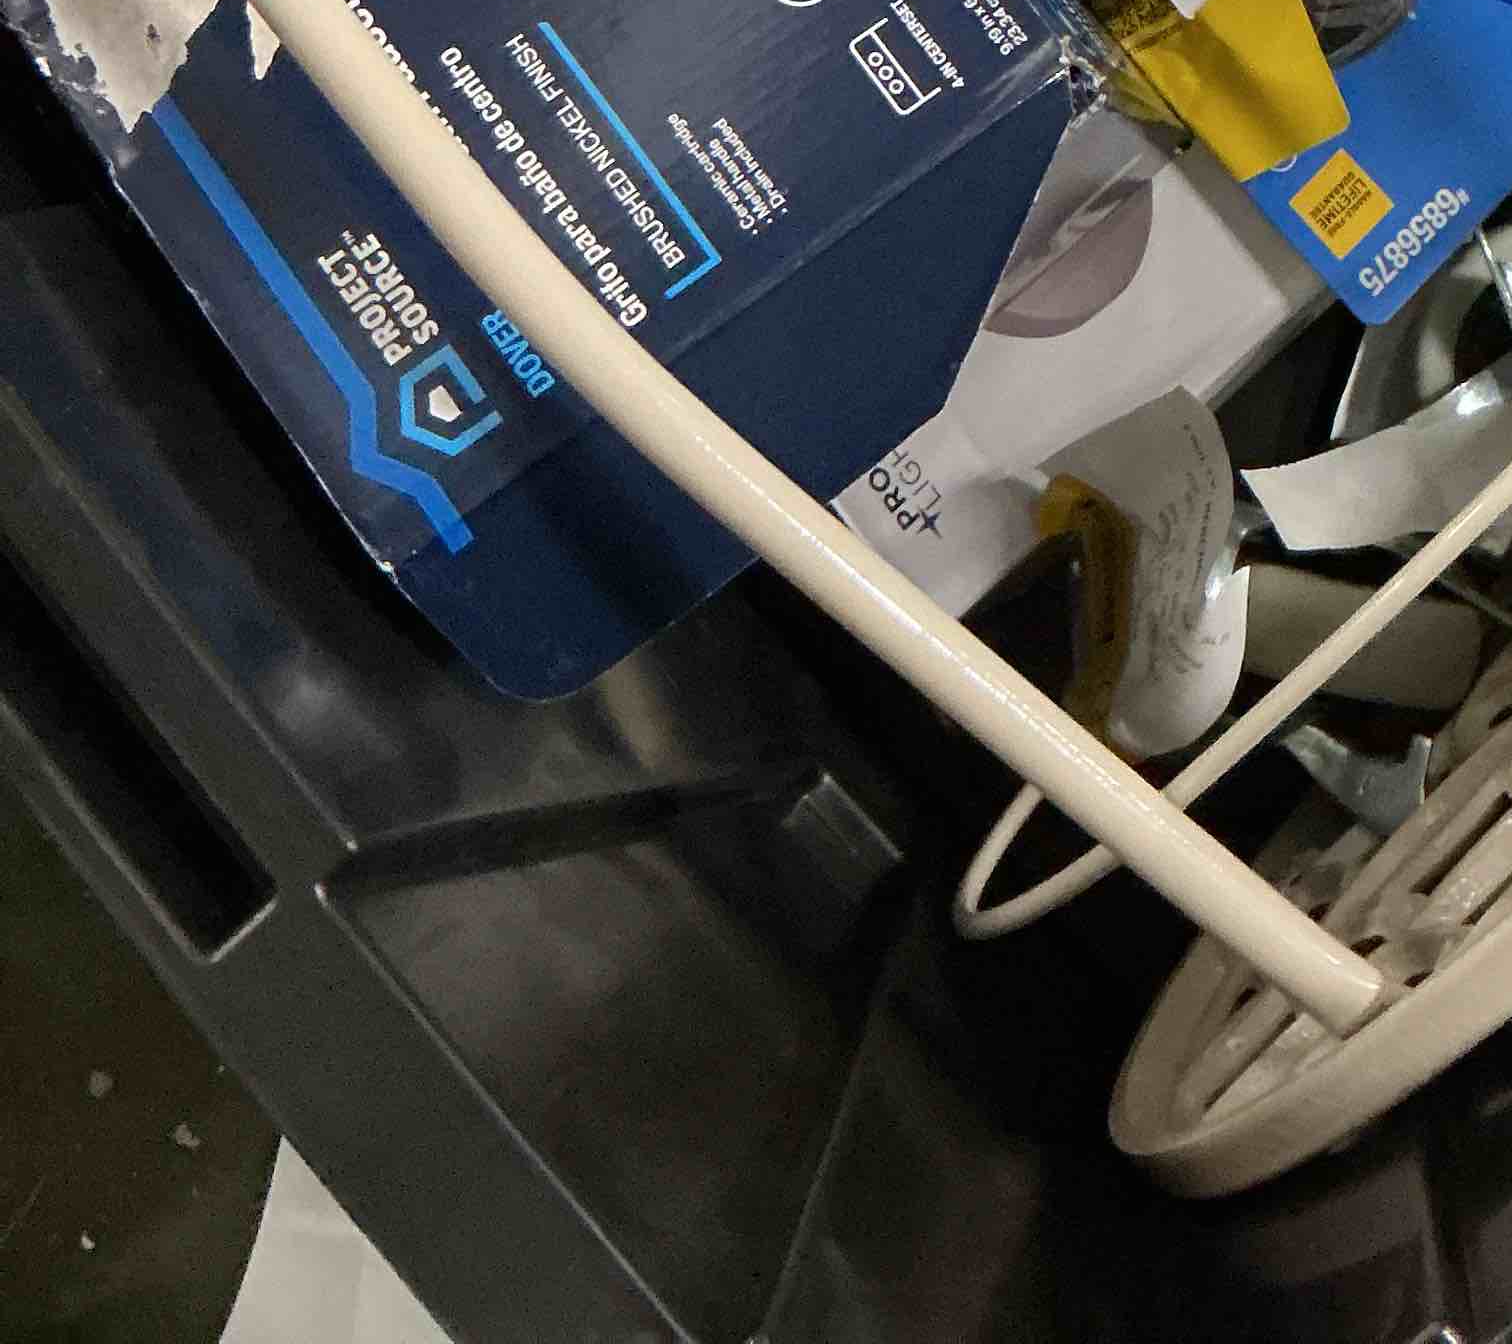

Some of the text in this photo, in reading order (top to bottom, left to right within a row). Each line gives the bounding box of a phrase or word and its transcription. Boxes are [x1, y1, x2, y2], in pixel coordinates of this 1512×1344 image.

[890, 0, 965, 89] 4-IN CENTERSET
[978, 14, 994, 30] in
[986, 26, 1014, 55] 9.19
[993, 7, 1028, 46] 23.34
[437, 45, 503, 125] centro
[490, 118, 525, 154] de
[506, 34, 684, 268] BRUSHED NICKEL FINISH
[668, 114, 755, 229] Ceramic cartridge
[712, 118, 786, 209] Drain included
[516, 150, 566, 214] baño
[709, 138, 771, 219] Metal handle
[1314, 177, 1367, 230] LIFETIME
[557, 205, 611, 265] para
[318, 251, 411, 364] PROJECT
[352, 235, 438, 344] SOURCE
[592, 260, 648, 327] Grifo
[482, 309, 554, 396] DOVER
[869, 468, 920, 530] PRO
